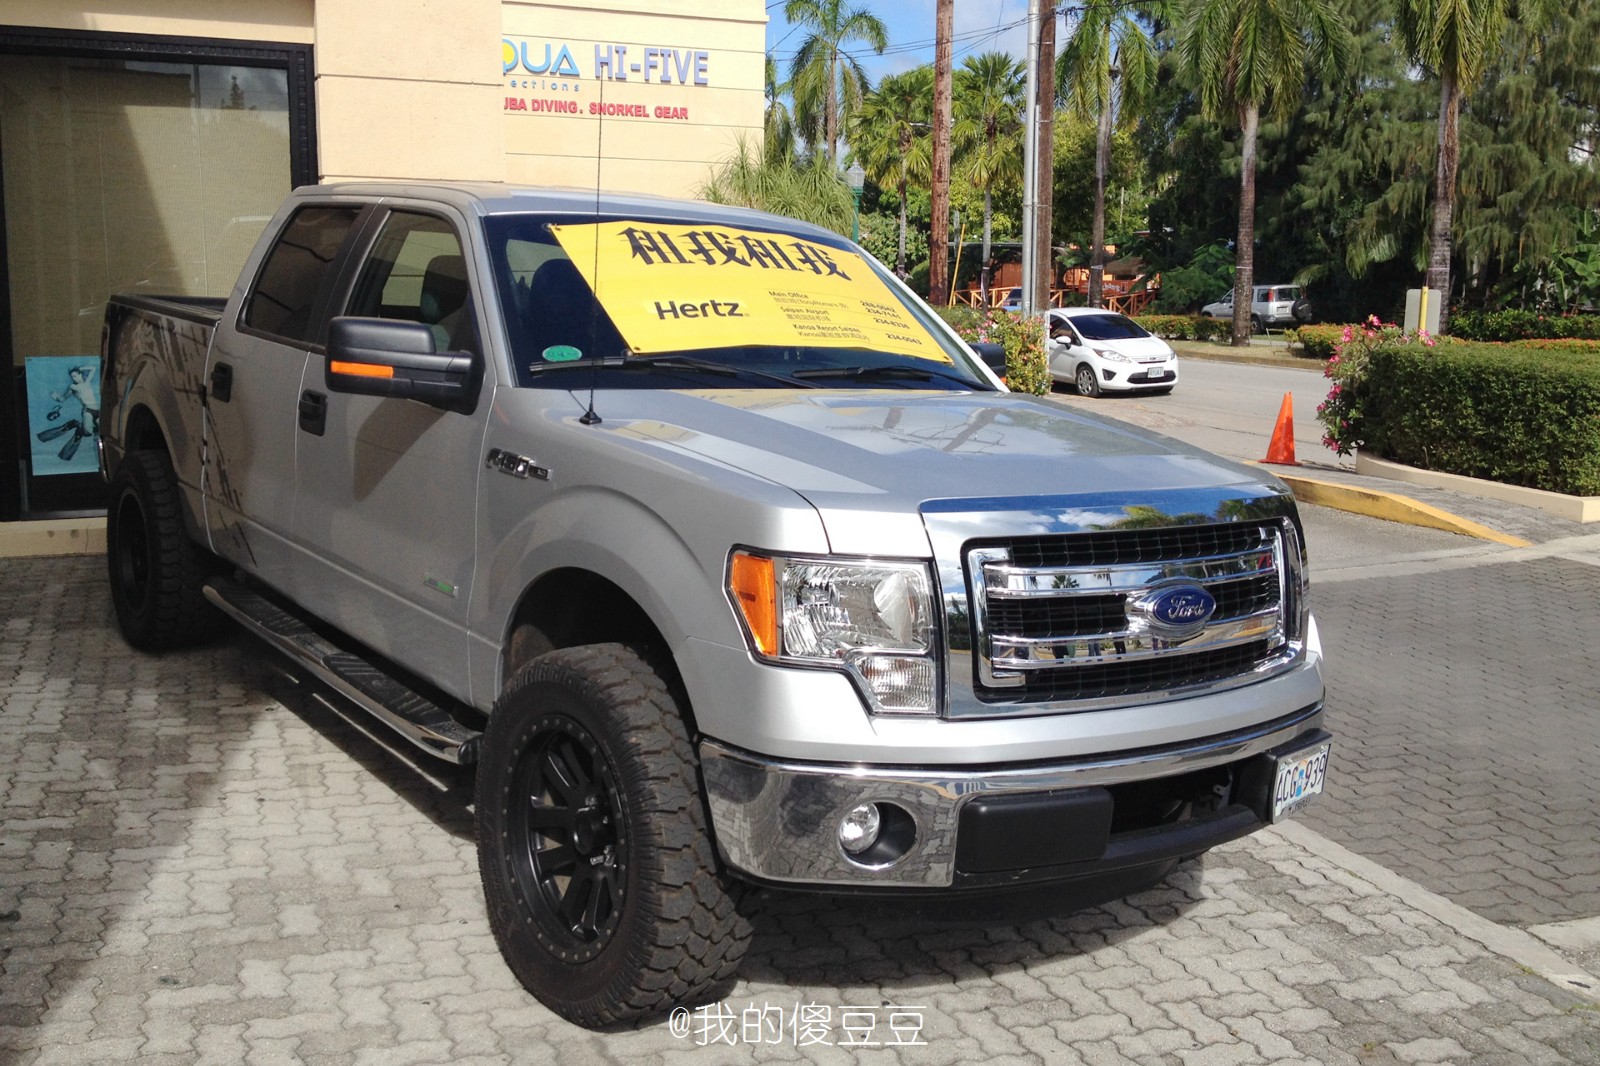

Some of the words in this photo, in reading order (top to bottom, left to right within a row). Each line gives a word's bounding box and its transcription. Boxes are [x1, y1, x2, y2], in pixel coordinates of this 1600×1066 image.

[594, 43, 709, 87] HI-FIVE
[589, 102, 650, 118] SNORKEL
[654, 105, 689, 120] GEAR
[653, 299, 744, 320] Hertz
[1168, 594, 1205, 619] Ford
